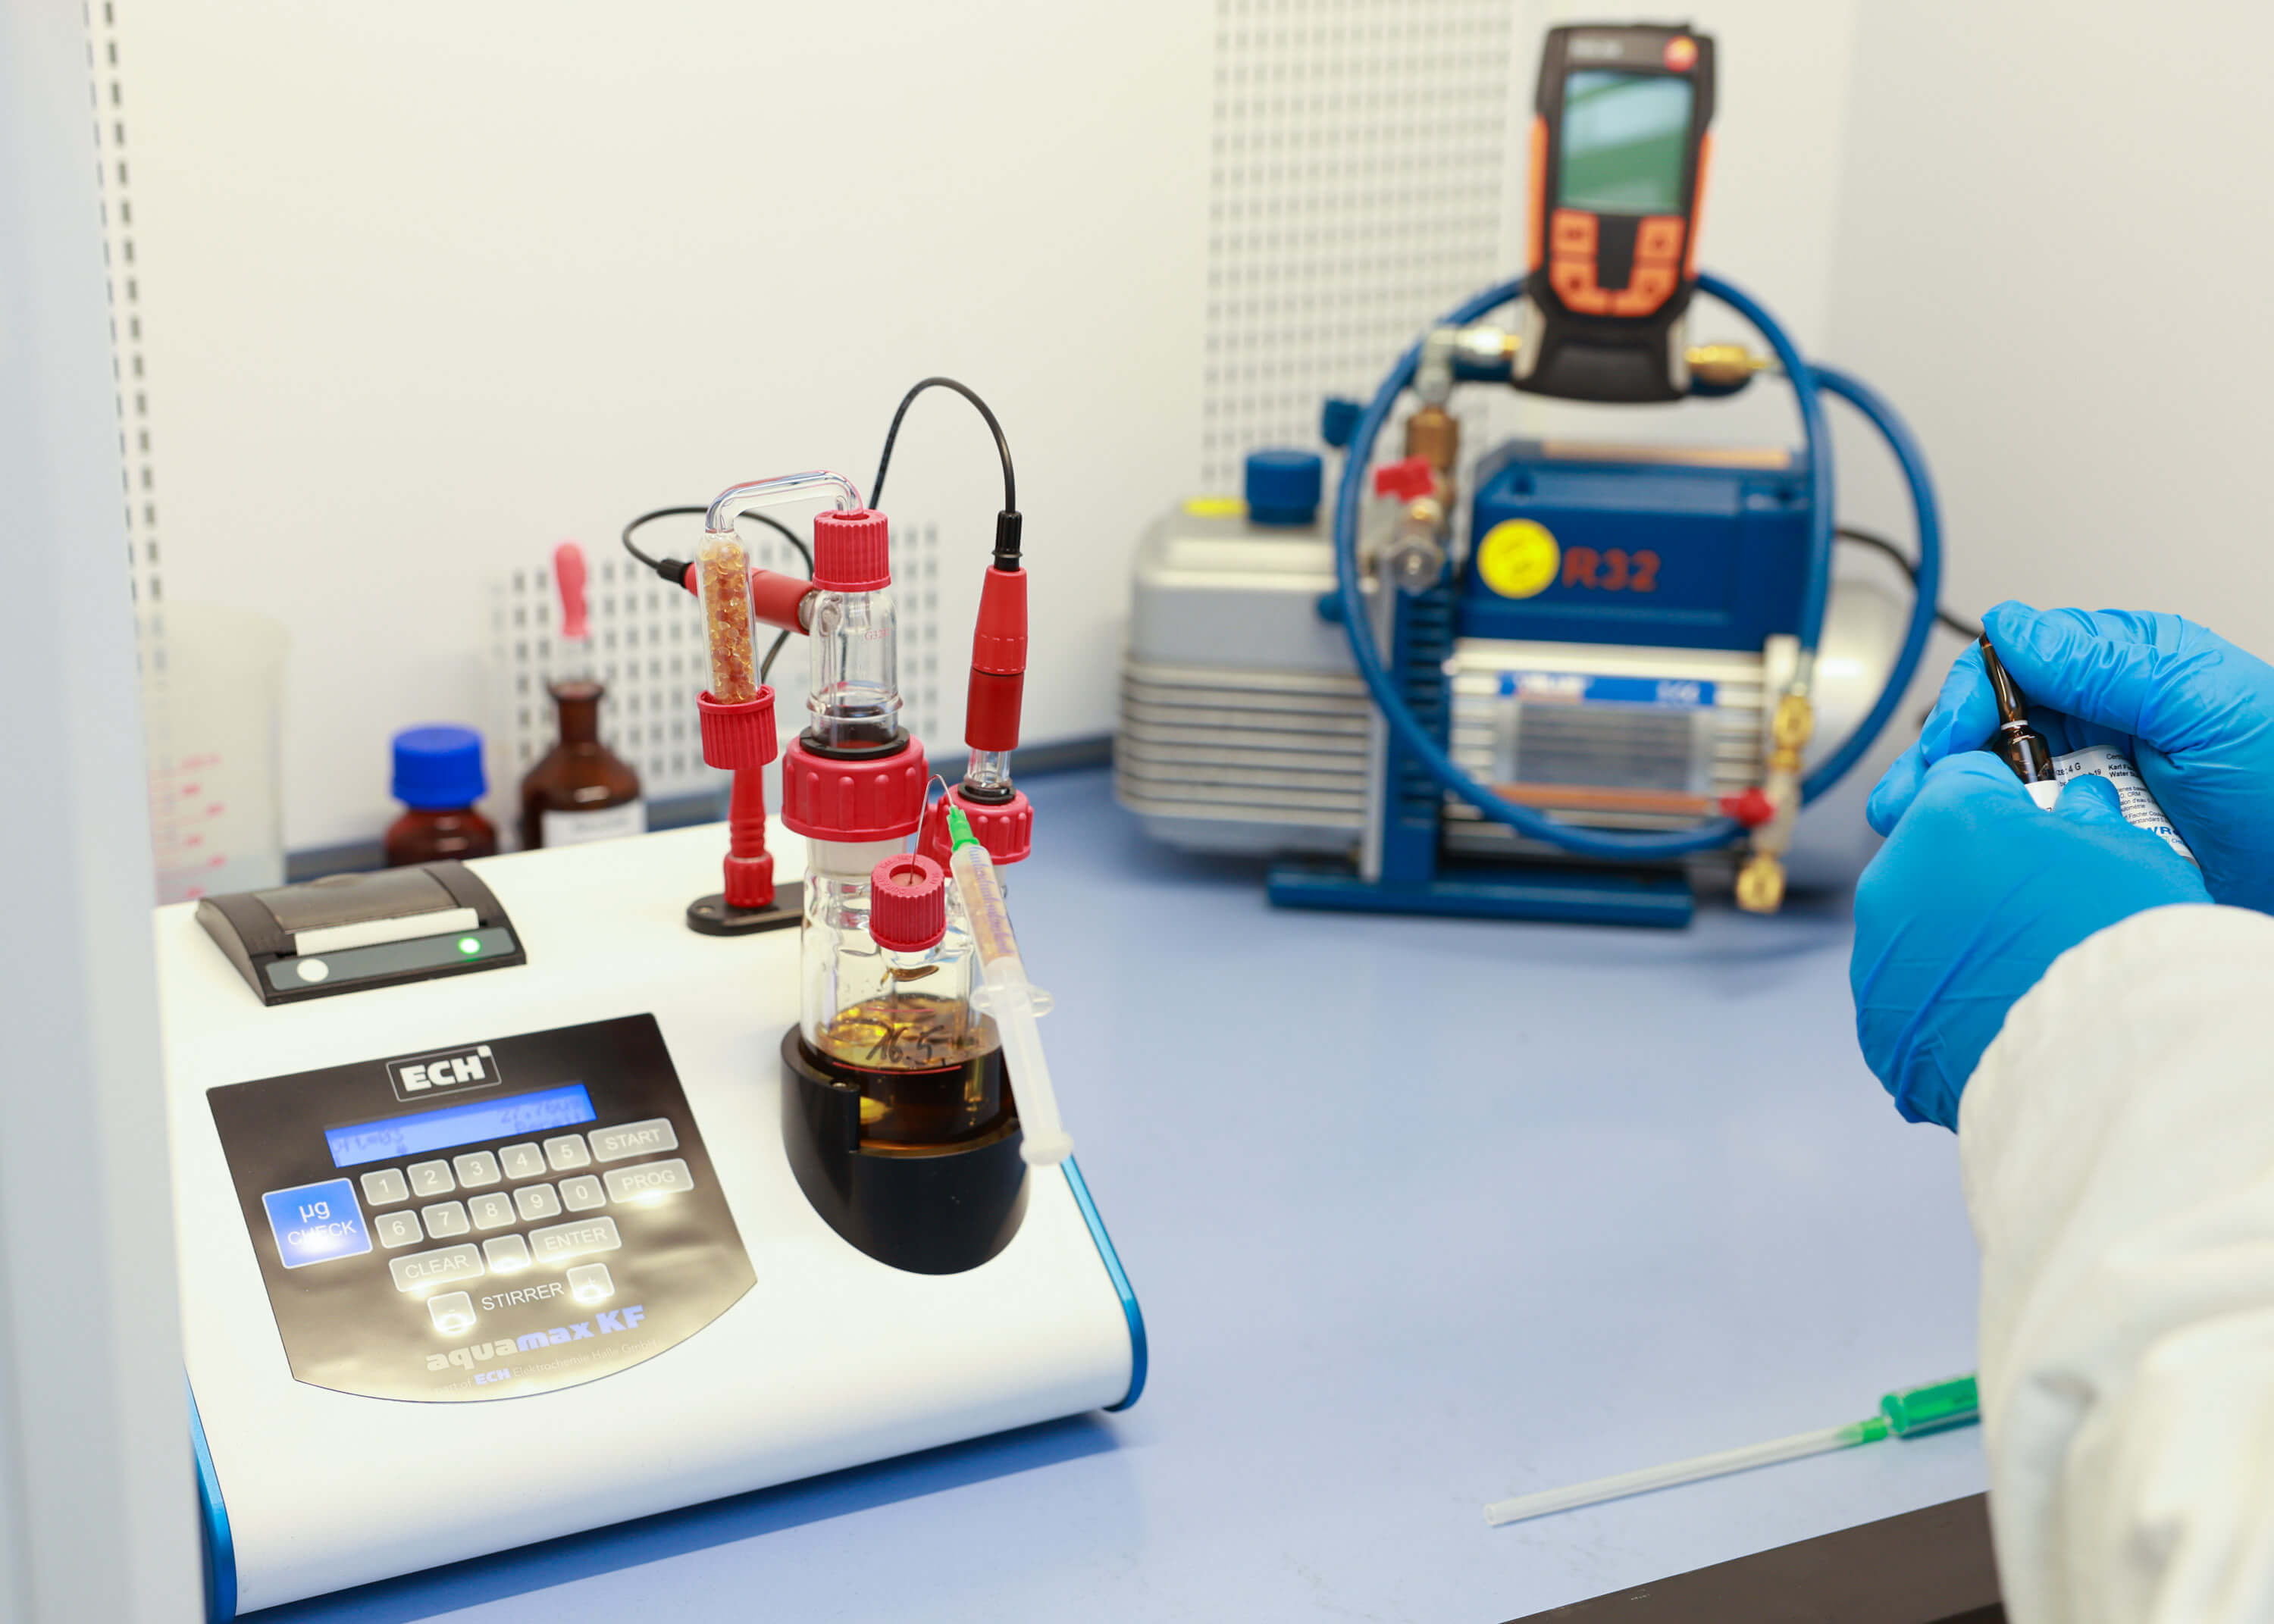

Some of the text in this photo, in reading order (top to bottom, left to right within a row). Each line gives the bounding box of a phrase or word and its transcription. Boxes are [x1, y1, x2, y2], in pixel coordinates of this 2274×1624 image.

[1562, 546, 1660, 593] R32
[399, 1054, 486, 1092] ECH
[378, 1128, 662, 1194] 1 2 3 4 5 START
[391, 1220, 406, 1236] 6
[437, 1211, 450, 1227] 7
[484, 1202, 498, 1218] 8
[530, 1194, 544, 1209] 9
[622, 1169, 676, 1191] PROG
[287, 1219, 357, 1246] CHECK
[405, 1226, 608, 1279] CLEAR ENTER
[481, 1281, 565, 1311] STIRRER
[425, 1304, 646, 1372] aquamax KF
[473, 1368, 511, 1386] ECH
